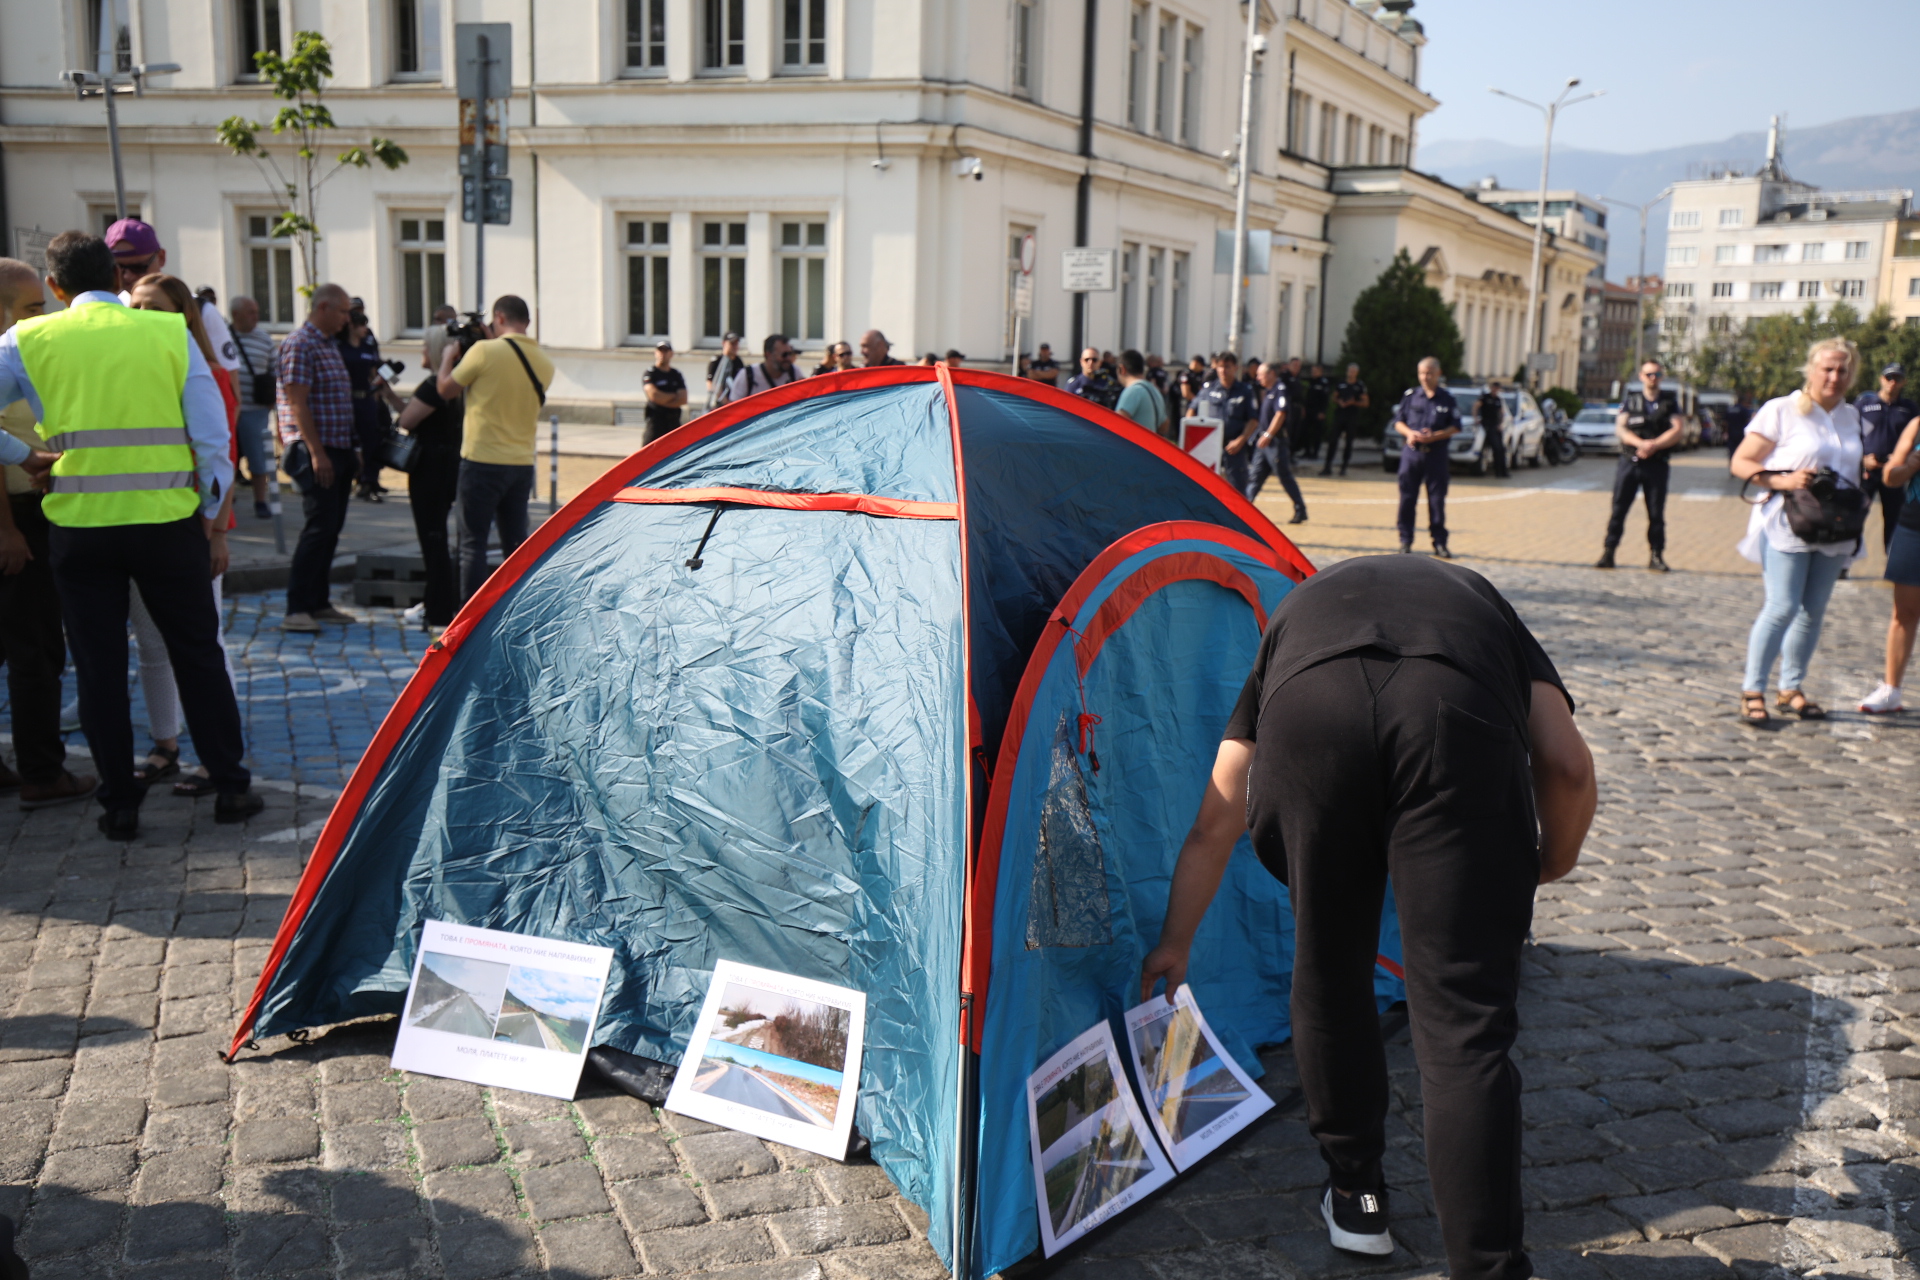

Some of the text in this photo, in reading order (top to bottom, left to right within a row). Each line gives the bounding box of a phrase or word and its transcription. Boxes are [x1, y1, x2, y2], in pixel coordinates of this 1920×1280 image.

[440, 933, 458, 943] ТОВА
[464, 938, 508, 951] ПРОМЯНАТА,
[509, 945, 533, 955] КОЯТО
[533, 948, 547, 957] НИЕ
[548, 951, 597, 964] НАПРАВИХМЕ!
[479, 1049, 508, 1060] ПЛАТЕТЕ
